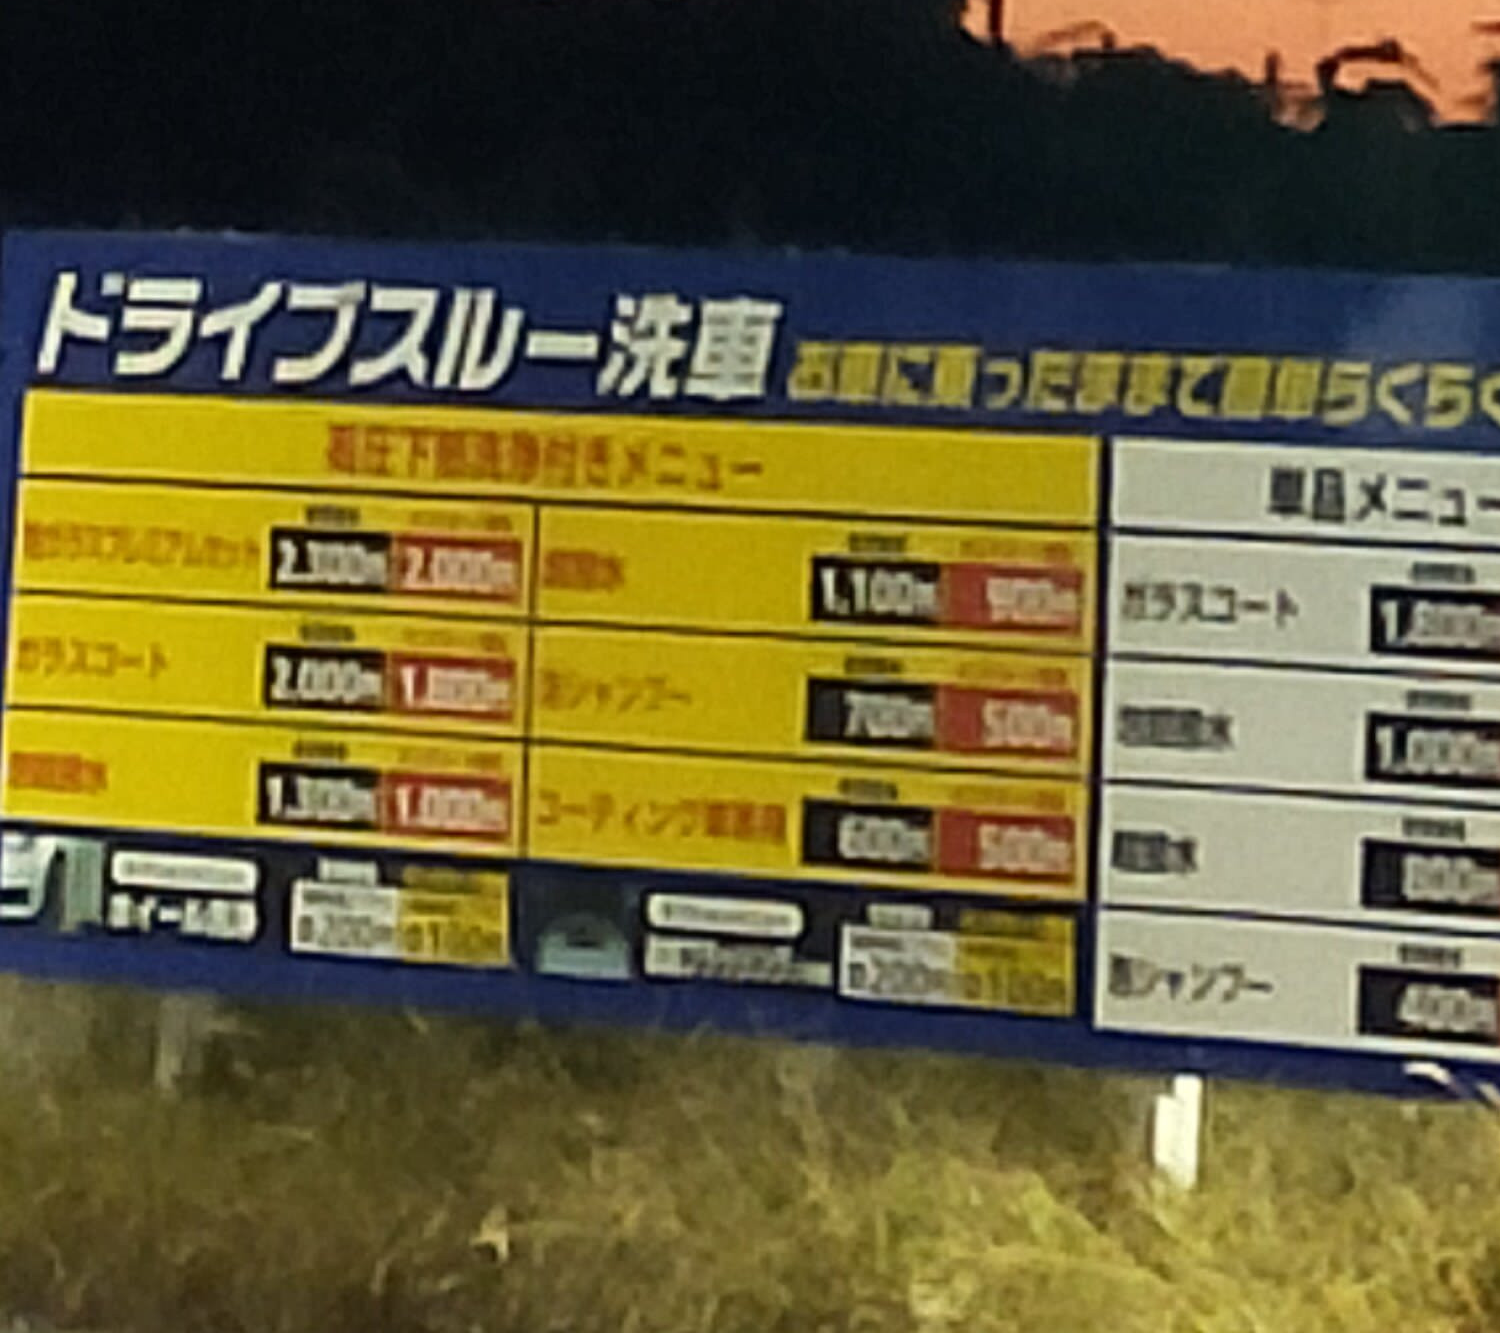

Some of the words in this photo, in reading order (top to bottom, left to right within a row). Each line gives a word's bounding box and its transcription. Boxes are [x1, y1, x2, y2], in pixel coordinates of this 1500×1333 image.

[38, 271, 782, 400] ドライブスルー洗車
[1120, 581, 1299, 629] ガラスコート
